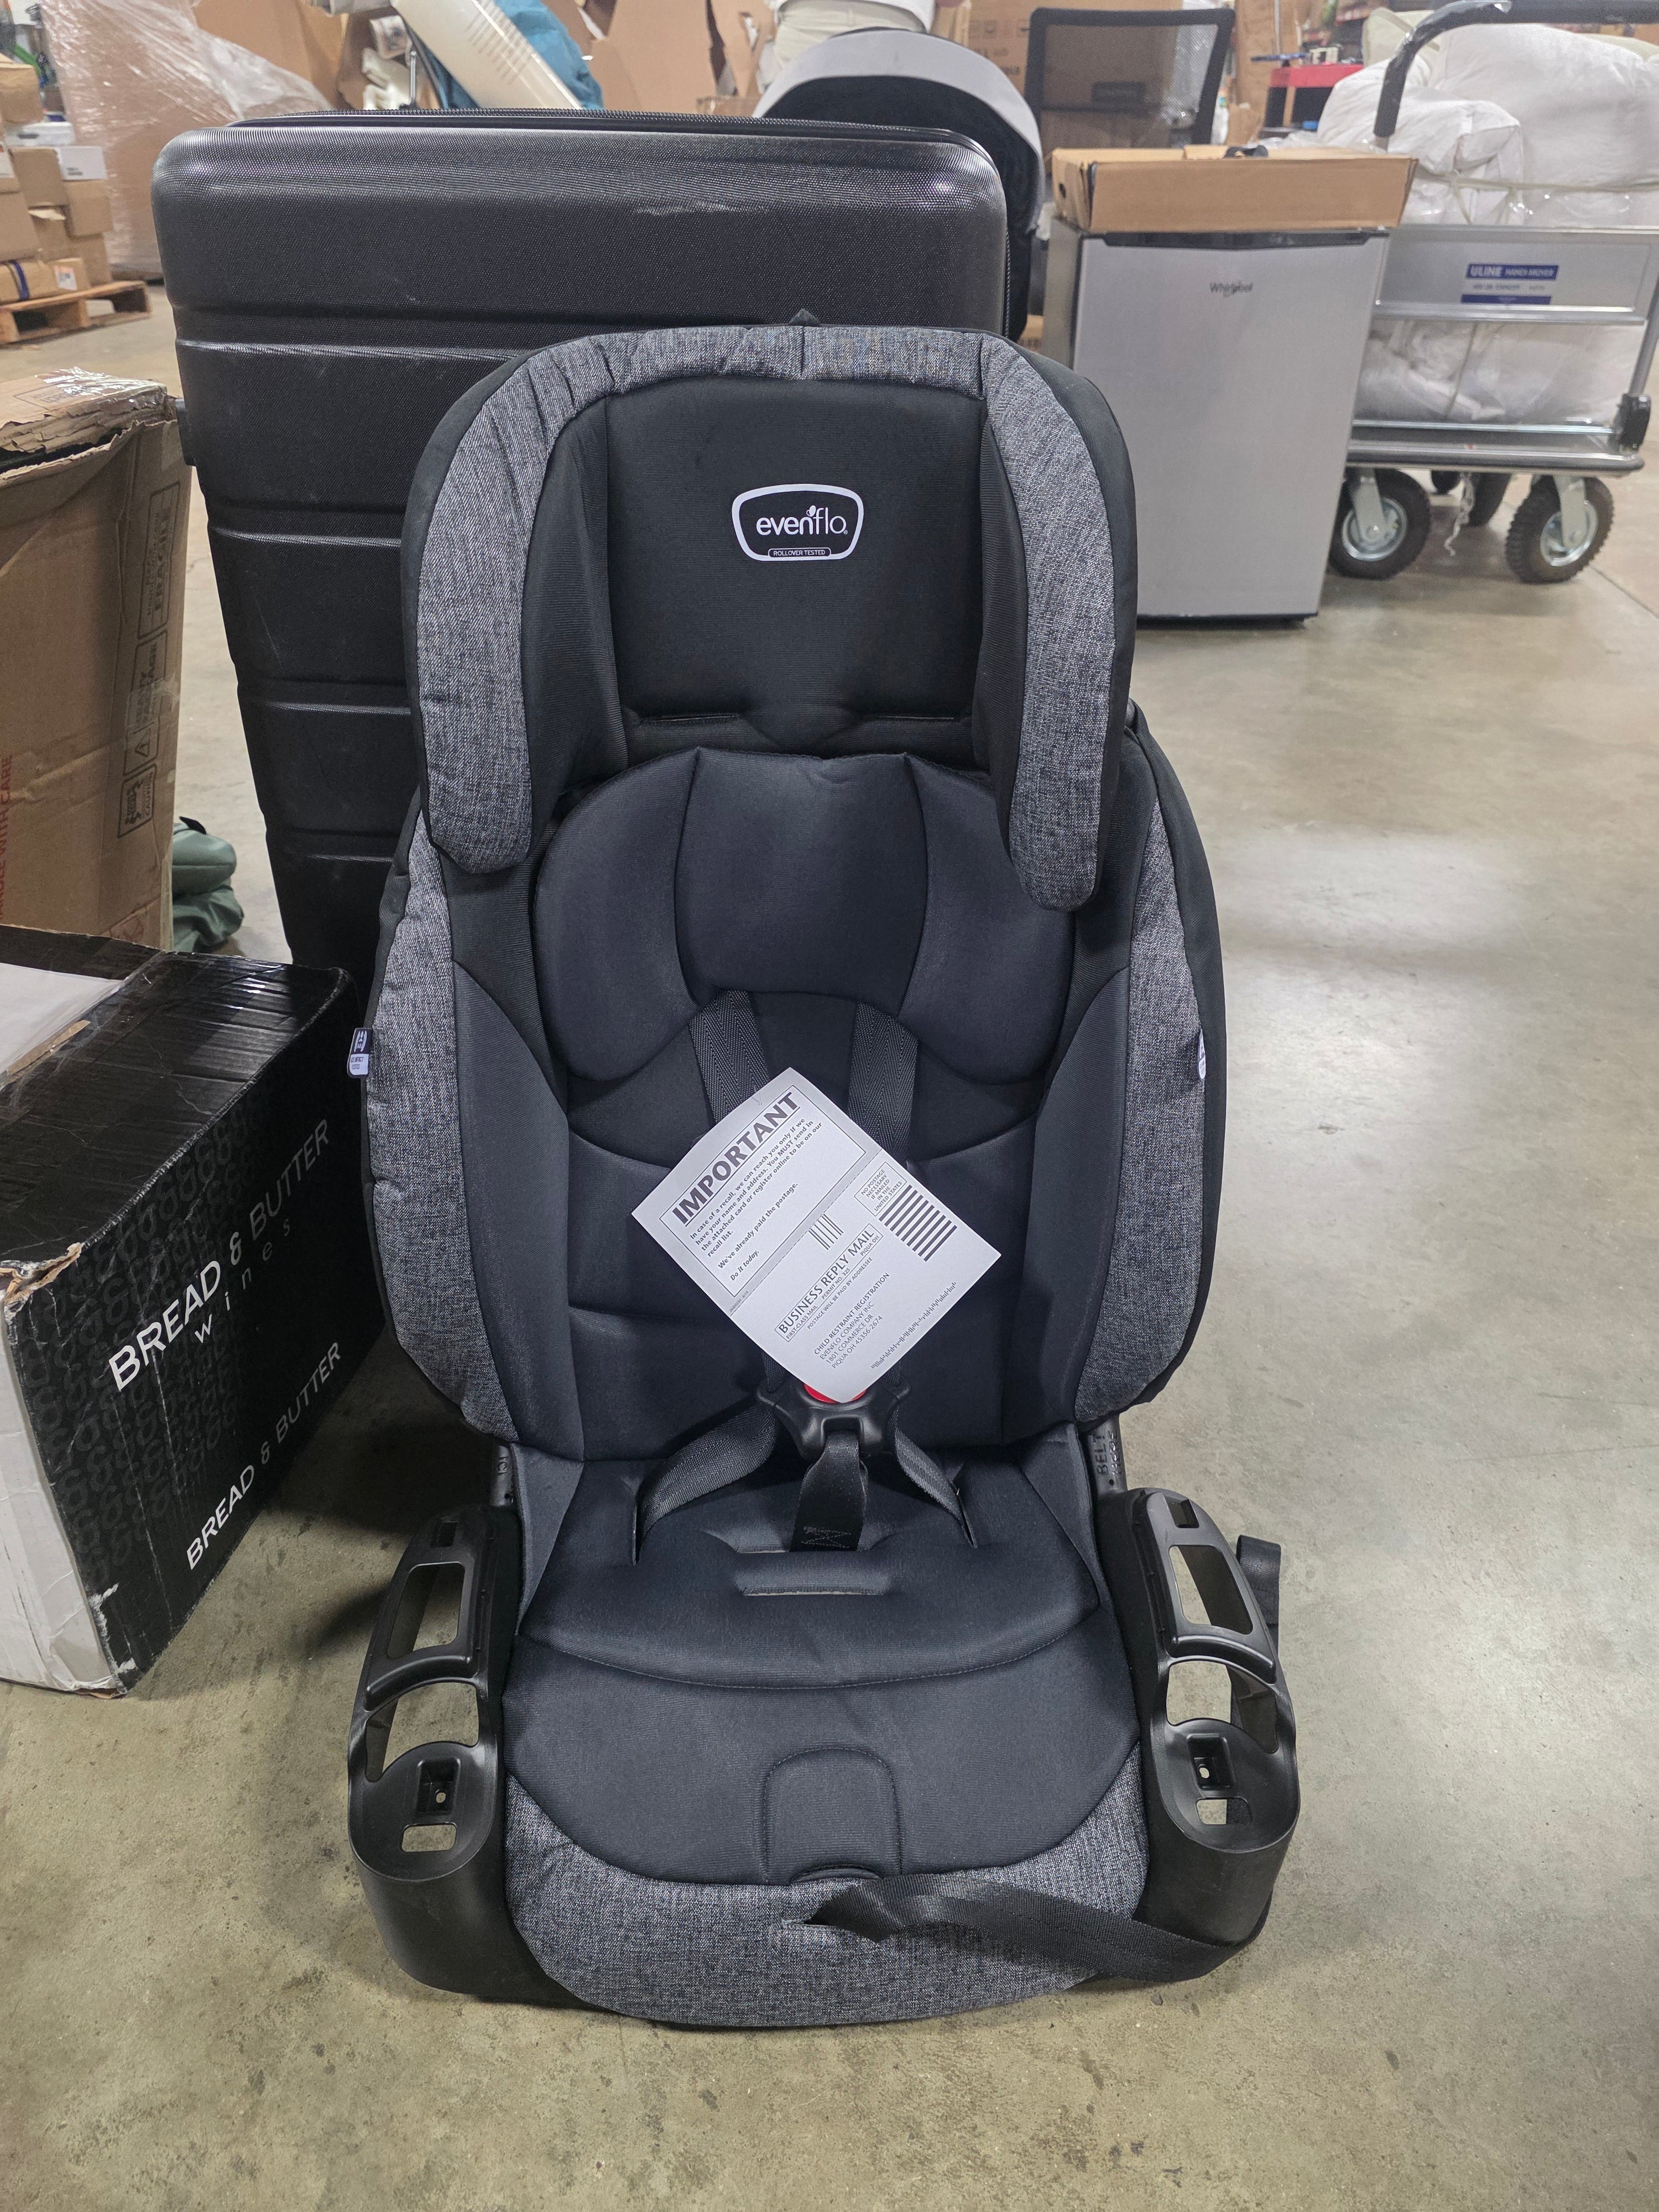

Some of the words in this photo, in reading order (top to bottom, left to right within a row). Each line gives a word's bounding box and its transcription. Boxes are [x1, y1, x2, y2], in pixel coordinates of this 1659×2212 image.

[756, 505, 847, 536] evenflo
[671, 1091, 798, 1225] IMPORTANT
[695, 1231, 710, 1245] have
[708, 1217, 722, 1234] your
[721, 1202, 737, 1218] name
[736, 1189, 747, 1202] and
[746, 1168, 769, 1191] address.
[766, 1156, 779, 1167] You
[777, 1139, 794, 1157] MUST
[794, 1126, 807, 1141] send
[697, 1220, 709, 1233] case
[708, 1211, 716, 1220] of
[719, 1191, 737, 1209] recall,
[735, 1182, 744, 1191] we
[743, 1171, 754, 1182] can
[753, 1155, 769, 1172] reach
[768, 1145, 779, 1158] you
[779, 1132, 791, 1145] only
[795, 1119, 805, 1128] we
[701, 1240, 712, 1251] the
[711, 1214, 735, 1241] attached
[734, 1201, 747, 1216] card
[746, 1194, 753, 1203] or
[753, 1172, 773, 1196] register
[773, 1155, 791, 1173] online
[795, 1140, 805, 1149] be
[804, 1133, 812, 1141] on
[812, 1122, 822, 1133] our
[860, 1187, 869, 1196] NO
[867, 1168, 885, 1188] POSTAGE
[865, 1173, 888, 1198] NECESSARY
[874, 1179, 890, 1196] MAILED
[874, 1195, 889, 1212] UNITED
[888, 1181, 902, 1197] STATES
[881, 1186, 891, 1195] THE
[109, 1261, 221, 1392] BREAD
[229, 1232, 242, 1266] &
[249, 1119, 328, 1241] BUTTER
[707, 1239, 723, 1258] recall
[721, 1230, 734, 1241] list.
[717, 1251, 735, 1269] We've
[734, 1230, 754, 1252] already
[754, 1215, 766, 1232] paid
[765, 1207, 776, 1217] the
[775, 1183, 798, 1208] postage.
[730, 1272, 739, 1281] Do
[743, 1250, 759, 1267] today.
[778, 1285, 823, 1334] BUSINESS
[820, 1254, 849, 1287] REPLY
[847, 1230, 875, 1257] MAIL
[786, 1314, 808, 1339] FIRST-CLASS
[806, 1305, 818, 1317] MAIL
[821, 1283, 836, 1300] PERMIT
[834, 1276, 844, 1285] NO.
[841, 1267, 851, 1277] 325
[859, 1243, 874, 1256] PIQUA
[872, 1235, 880, 1243] OH
[807, 1310, 825, 1330] POSTAGE
[822, 1301, 834, 1311] WILL
[837, 1285, 847, 1296] PAID
[852, 1256, 873, 1281] ADDRESSEE
[814, 1338, 830, 1355] CHILD
[828, 1309, 855, 1339] RESTRAINT
[854, 1272, 890, 1311] REGISTRATION
[819, 1337, 841, 1360] EVENFLO
[840, 1311, 865, 1338] COMPANY
[862, 1301, 874, 1313] INC
[826, 1351, 839, 1364] 1801
[838, 1321, 867, 1352] COMMERCE
[864, 1314, 874, 1323] DR
[831, 1353, 849, 1369] PIQUA
[846, 1343, 857, 1353] OH
[855, 1315, 883, 1345] 45356-2674
[186, 1465, 254, 1570] BREAD
[261, 1441, 270, 1465] &
[276, 1342, 341, 1444] BUTTER
[1093, 1434, 1109, 1475] BELT
